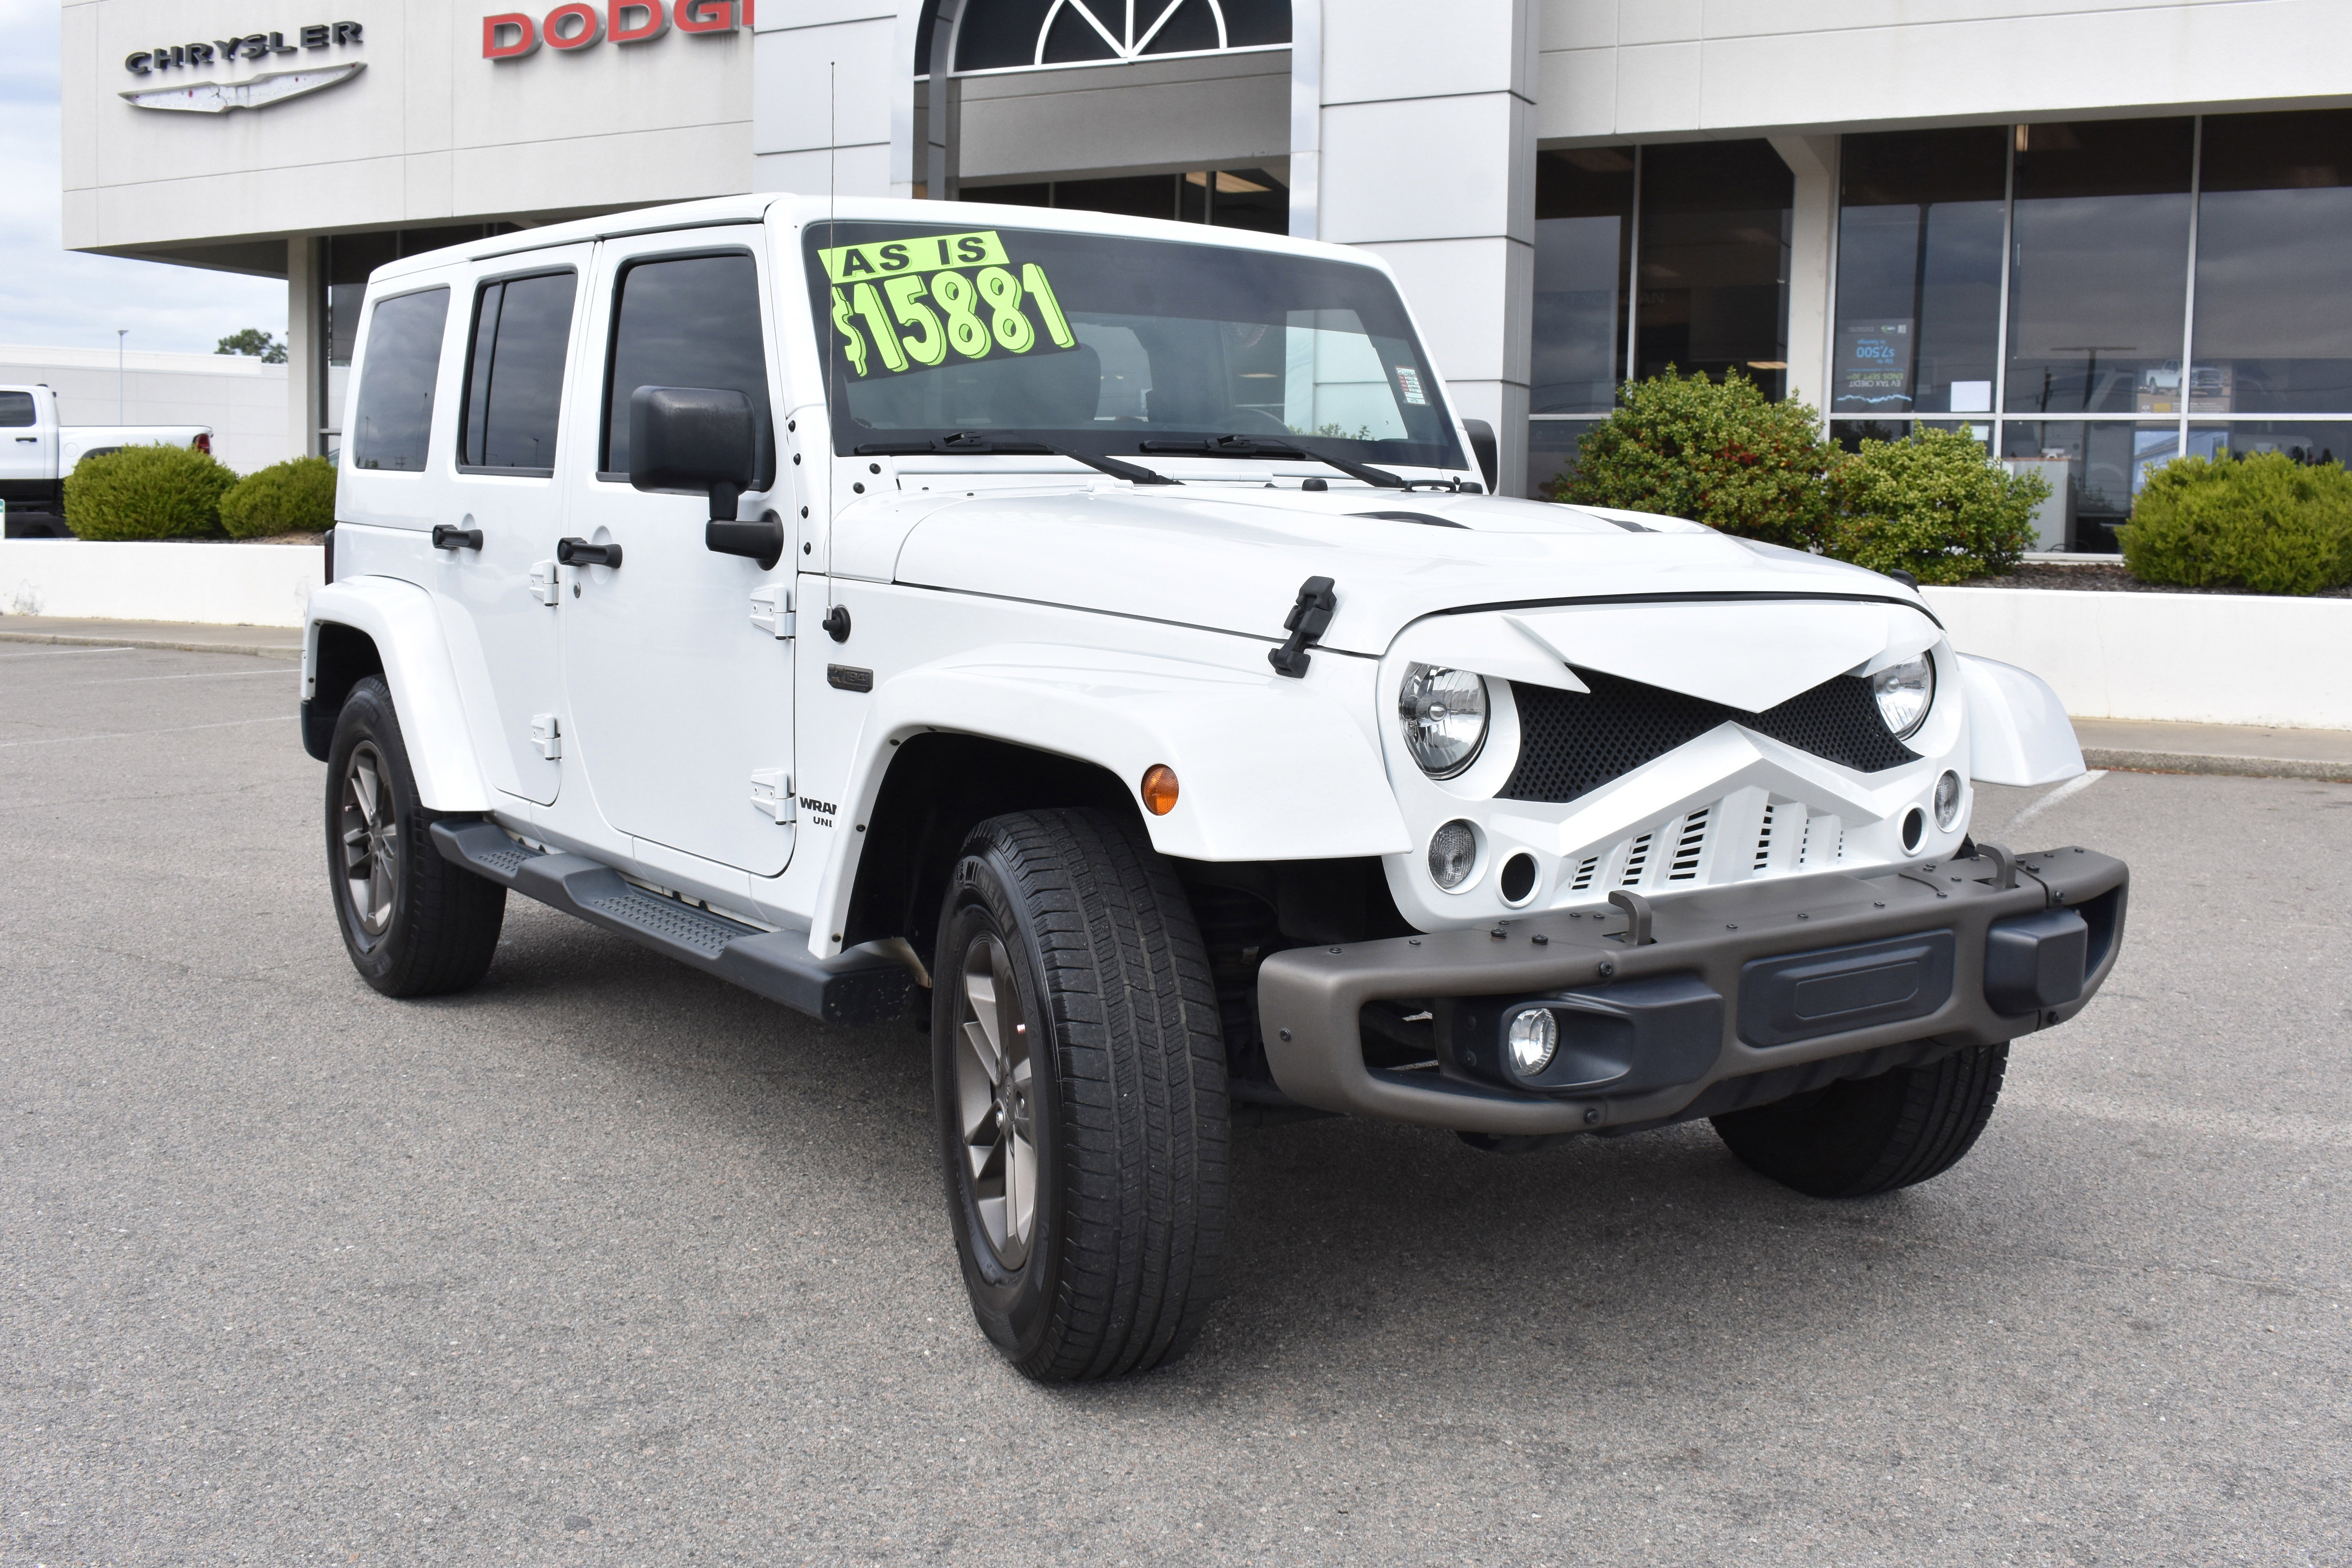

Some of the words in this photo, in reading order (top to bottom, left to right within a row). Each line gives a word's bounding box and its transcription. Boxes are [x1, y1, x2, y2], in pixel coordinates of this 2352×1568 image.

[125, 20, 363, 74] CHRYSLER
[482, 0, 754, 60] DODG
[842, 244, 912, 278] AS
[937, 236, 990, 266] IS
[832, 263, 1075, 376] $15881
[1856, 345, 1895, 358] $7,500
